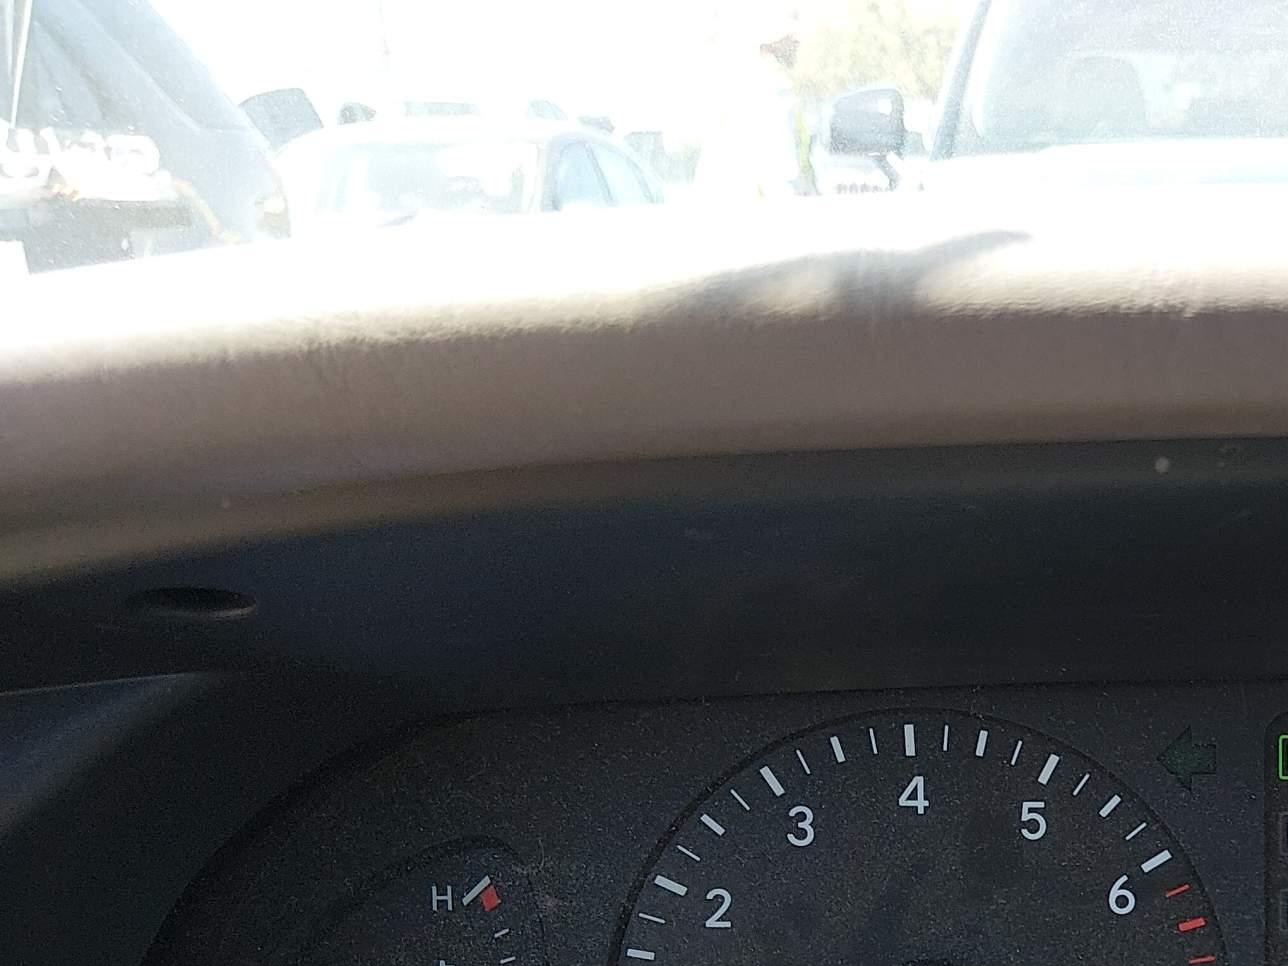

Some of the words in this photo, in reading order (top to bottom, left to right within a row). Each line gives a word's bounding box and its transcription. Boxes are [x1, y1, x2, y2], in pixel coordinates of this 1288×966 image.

[898, 776, 929, 814] 4
[787, 806, 814, 846] 3
[1020, 802, 1046, 840] 5
[432, 886, 452, 911] H
[705, 889, 732, 928] 2
[1108, 876, 1135, 914] 6
